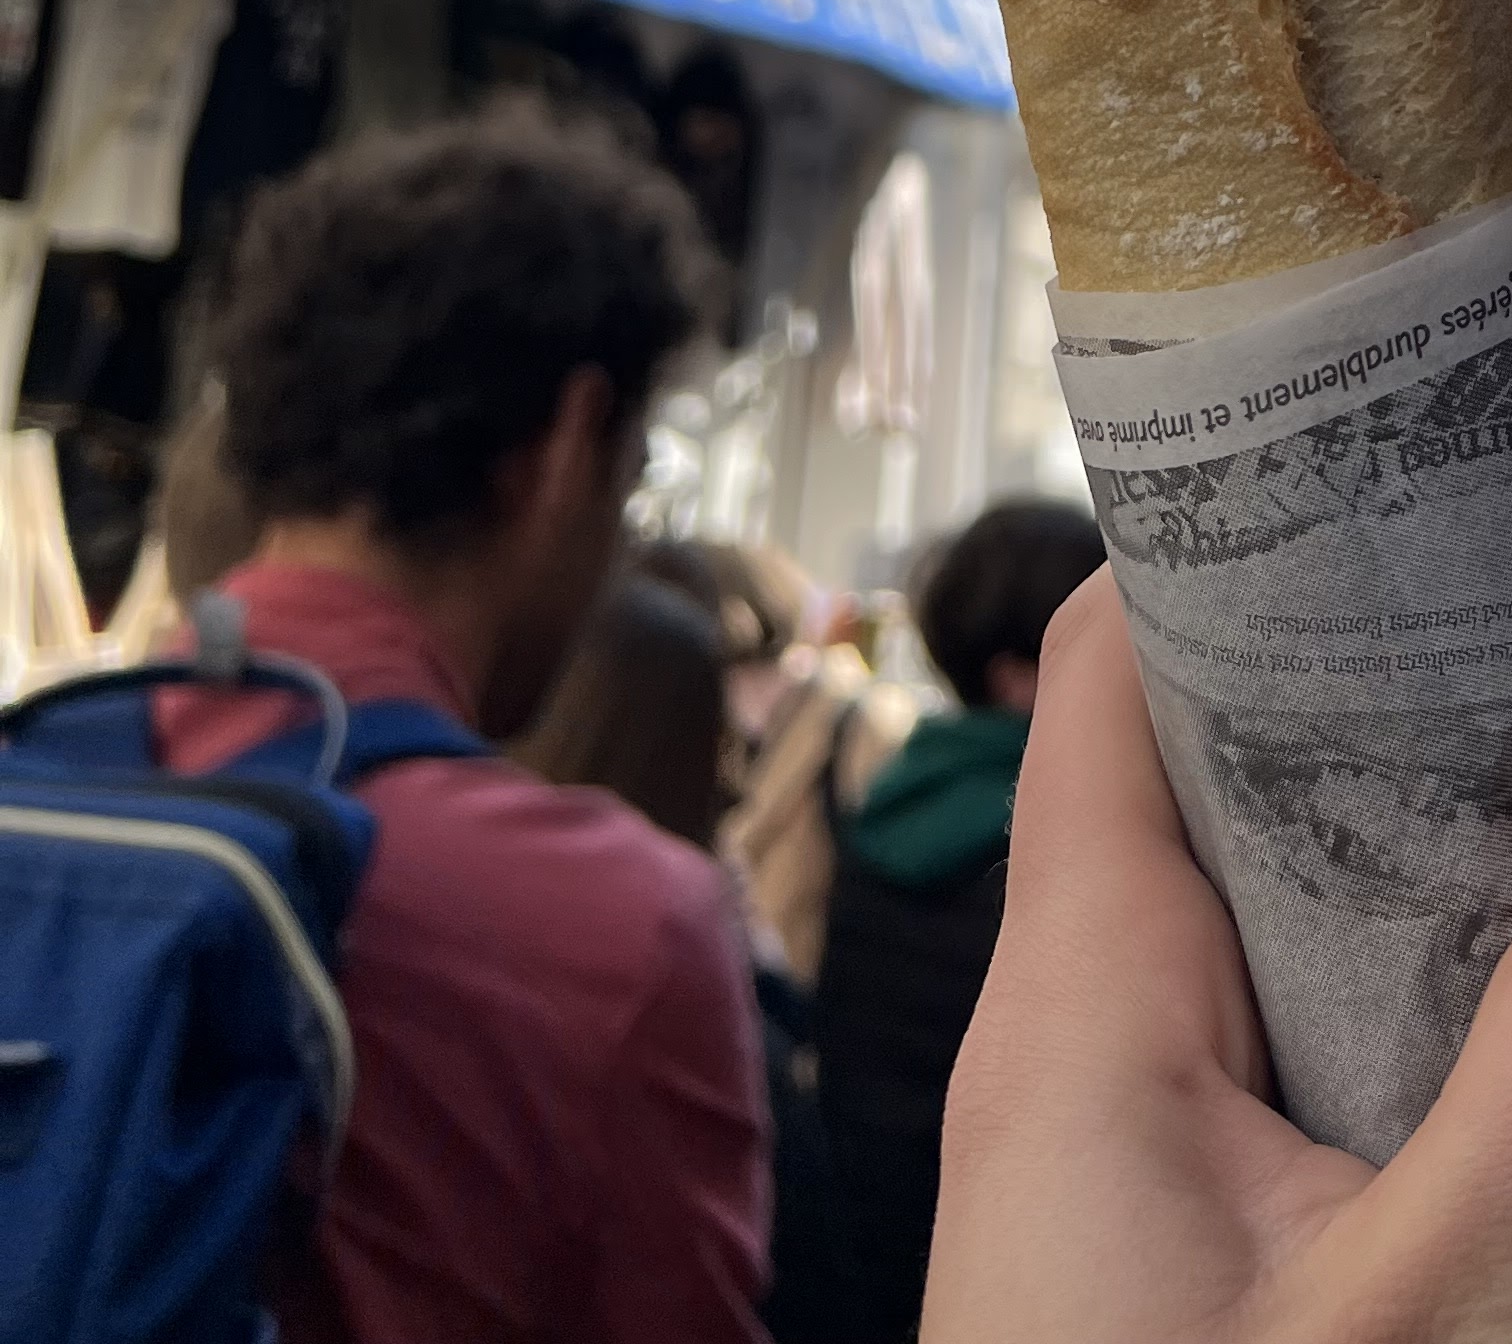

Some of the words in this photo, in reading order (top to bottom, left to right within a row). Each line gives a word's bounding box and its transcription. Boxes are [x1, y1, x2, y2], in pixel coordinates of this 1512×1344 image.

[1239, 322, 1431, 423] durablement
[1106, 408, 1196, 452] imprimé
[1201, 403, 1232, 434] et
